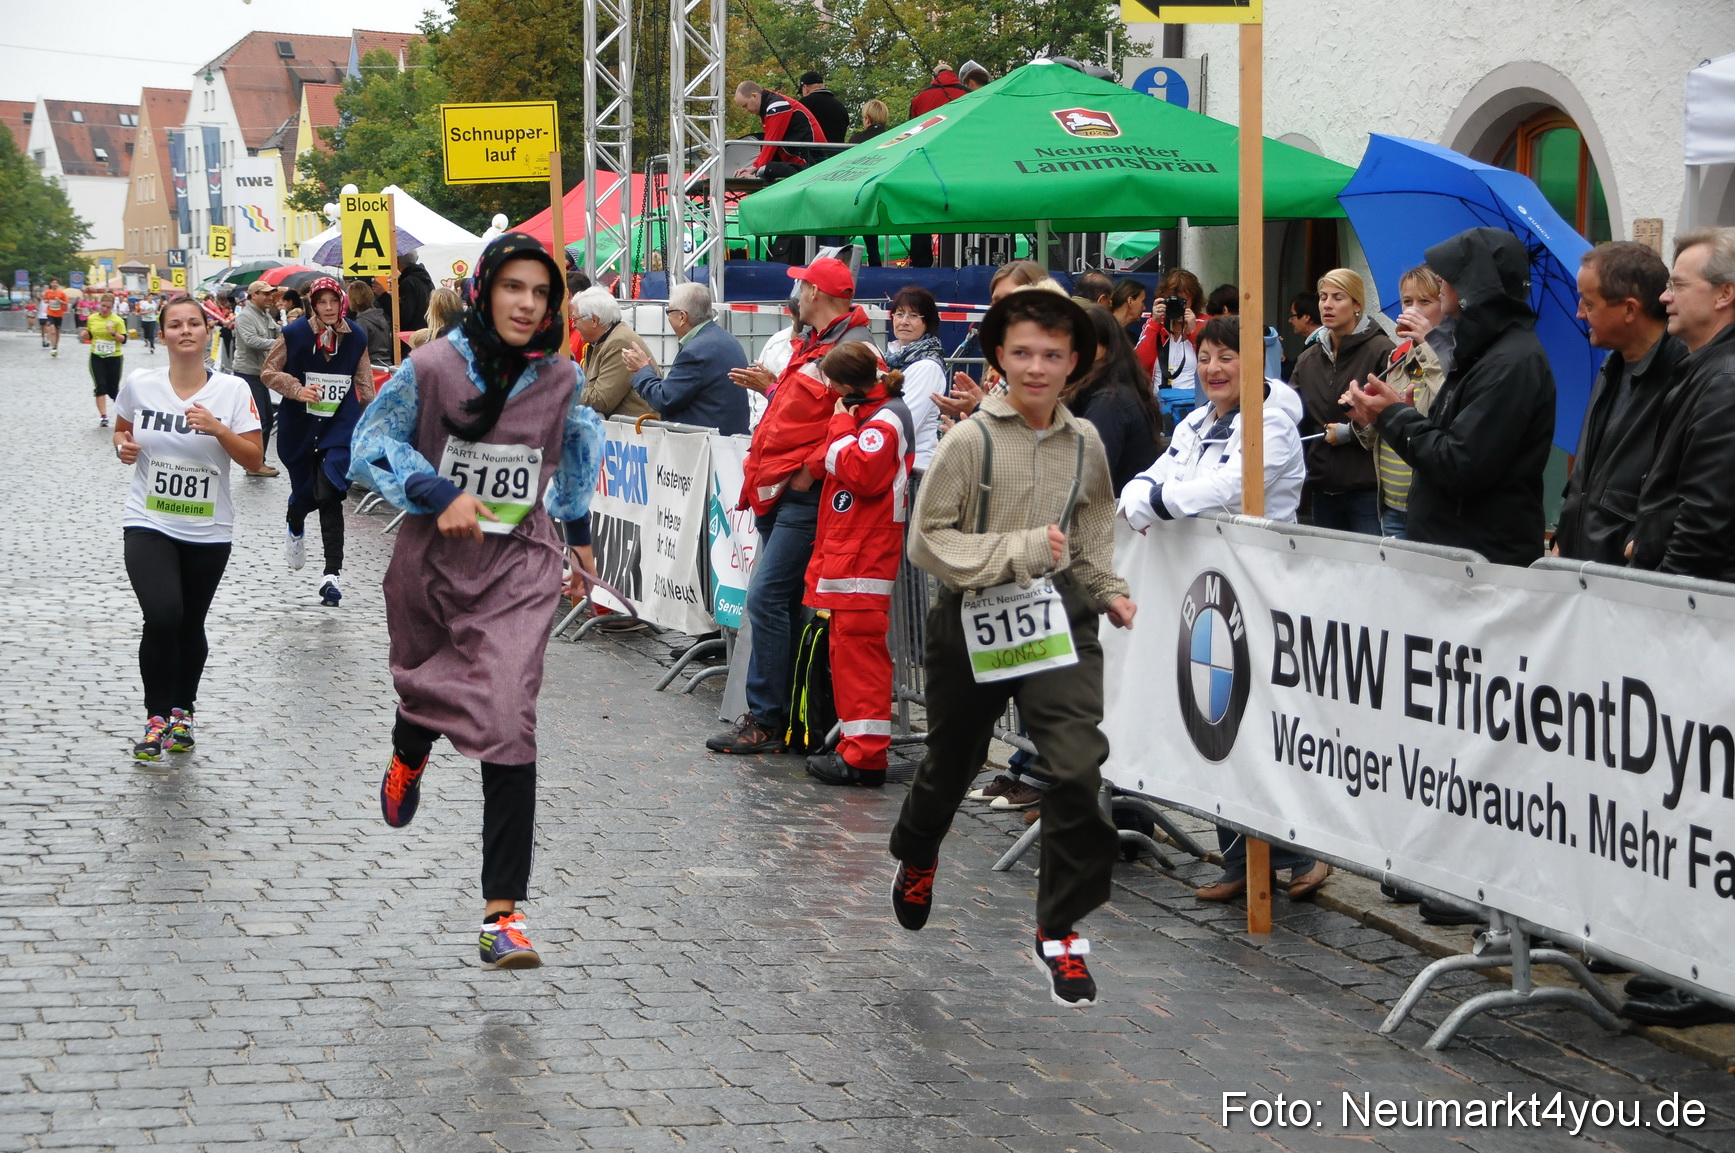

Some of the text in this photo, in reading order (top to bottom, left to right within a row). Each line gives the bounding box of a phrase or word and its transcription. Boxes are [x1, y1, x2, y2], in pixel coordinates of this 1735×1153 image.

[450, 127, 548, 143] Schnupper-
[485, 146, 517, 162] lauf
[1034, 145, 1180, 158] Neumarkter
[1013, 157, 1220, 174] Lammsbräu
[346, 197, 389, 211] Block
[215, 236, 226, 252] B
[354, 219, 385, 257] A
[152, 281, 159, 289] D
[175, 273, 183, 284] C
[310, 383, 347, 401] 185
[140, 409, 222, 436] THU
[446, 445, 524, 463] PARTL Neumarkt
[151, 460, 208, 474] PARTL Neumarkt
[155, 471, 210, 499] 5081
[449, 461, 530, 499] 5189
[156, 500, 204, 514] Madeleine
[963, 589, 1042, 610] PARTL Neumarkt
[1182, 575, 1244, 641] BMW
[973, 599, 1051, 646] 5157
[992, 640, 1047, 669] JONAS
[1269, 608, 1735, 810] BMW EfficientDyn
[1271, 710, 1735, 900] Weniger Verbrauch. Mehr Fa
